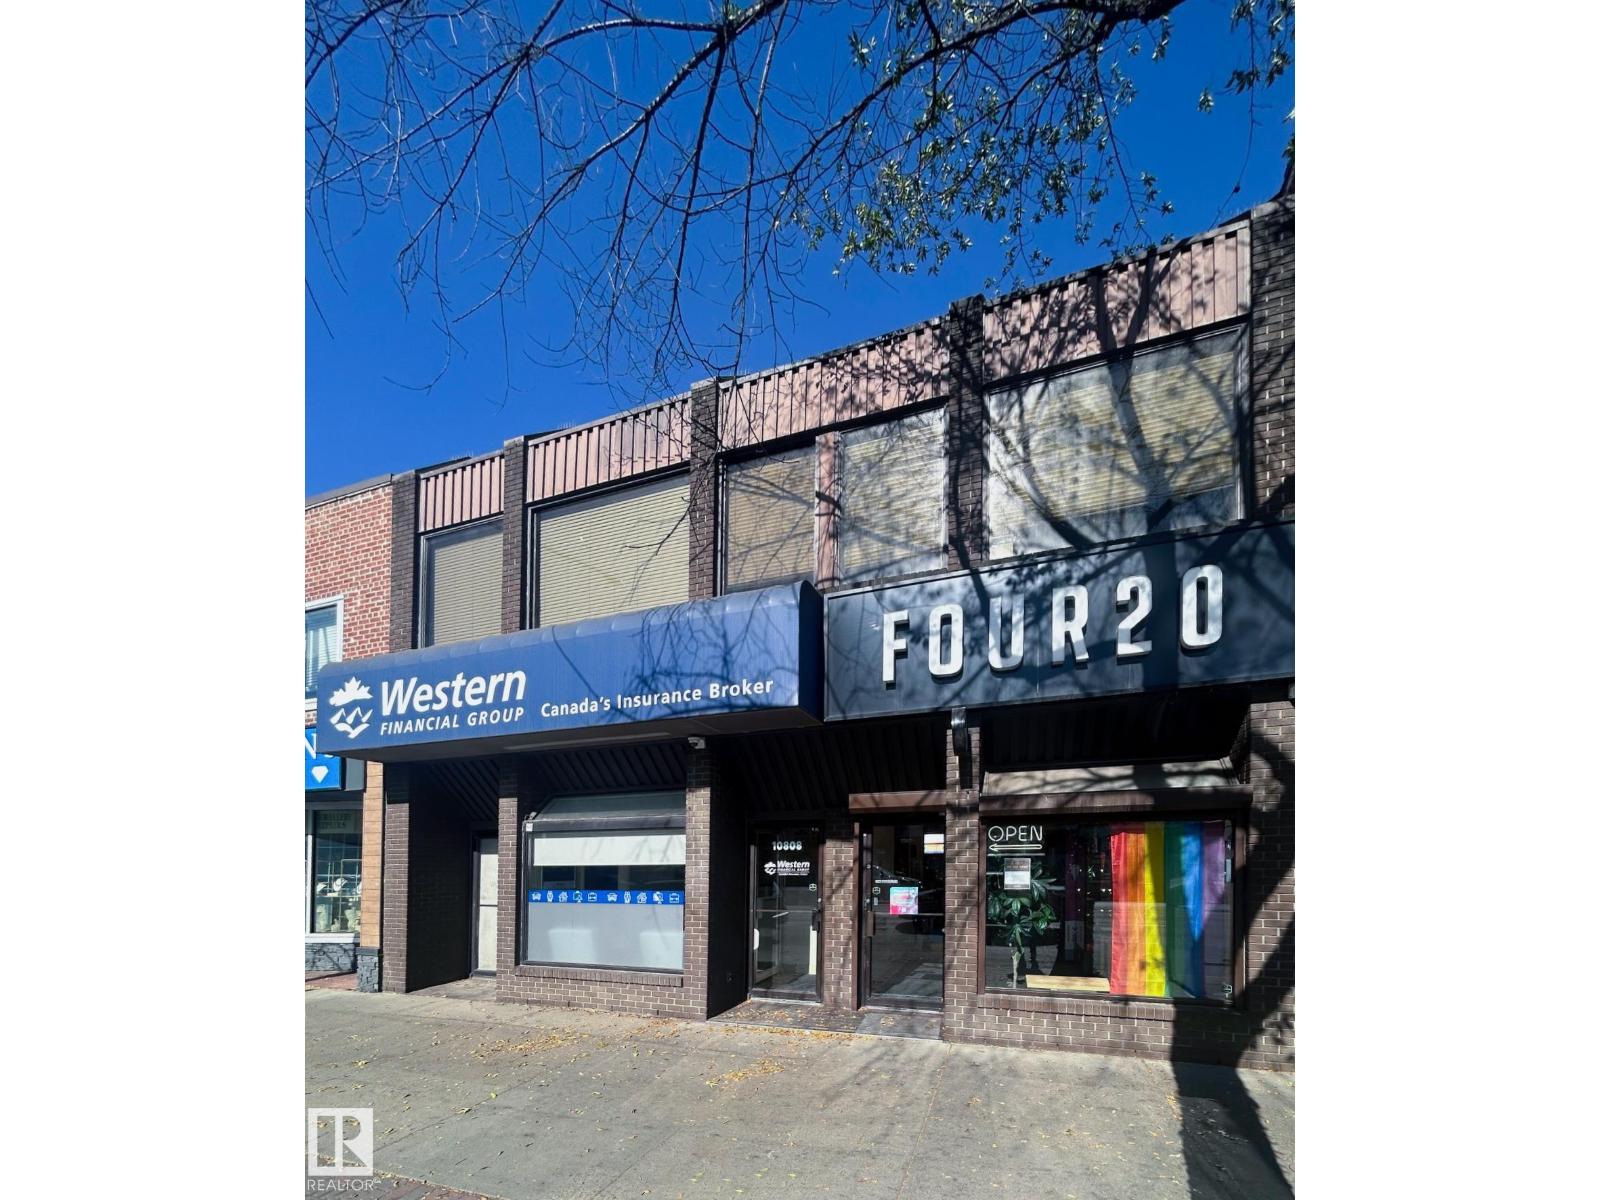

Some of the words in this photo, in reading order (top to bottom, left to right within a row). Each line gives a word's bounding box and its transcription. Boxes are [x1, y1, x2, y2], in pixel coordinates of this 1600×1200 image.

[882, 564, 1223, 684] FOUR20
[381, 670, 526, 716] Western
[541, 696, 611, 717] Canada's
[617, 688, 702, 709] Insurance
[709, 679, 774, 699] Broker
[380, 714, 460, 736] FINANCIAL
[467, 707, 525, 727] GROUP
[772, 841, 802, 851] 10808
[988, 825, 1043, 842] OPEN
[777, 860, 810, 868] Western
